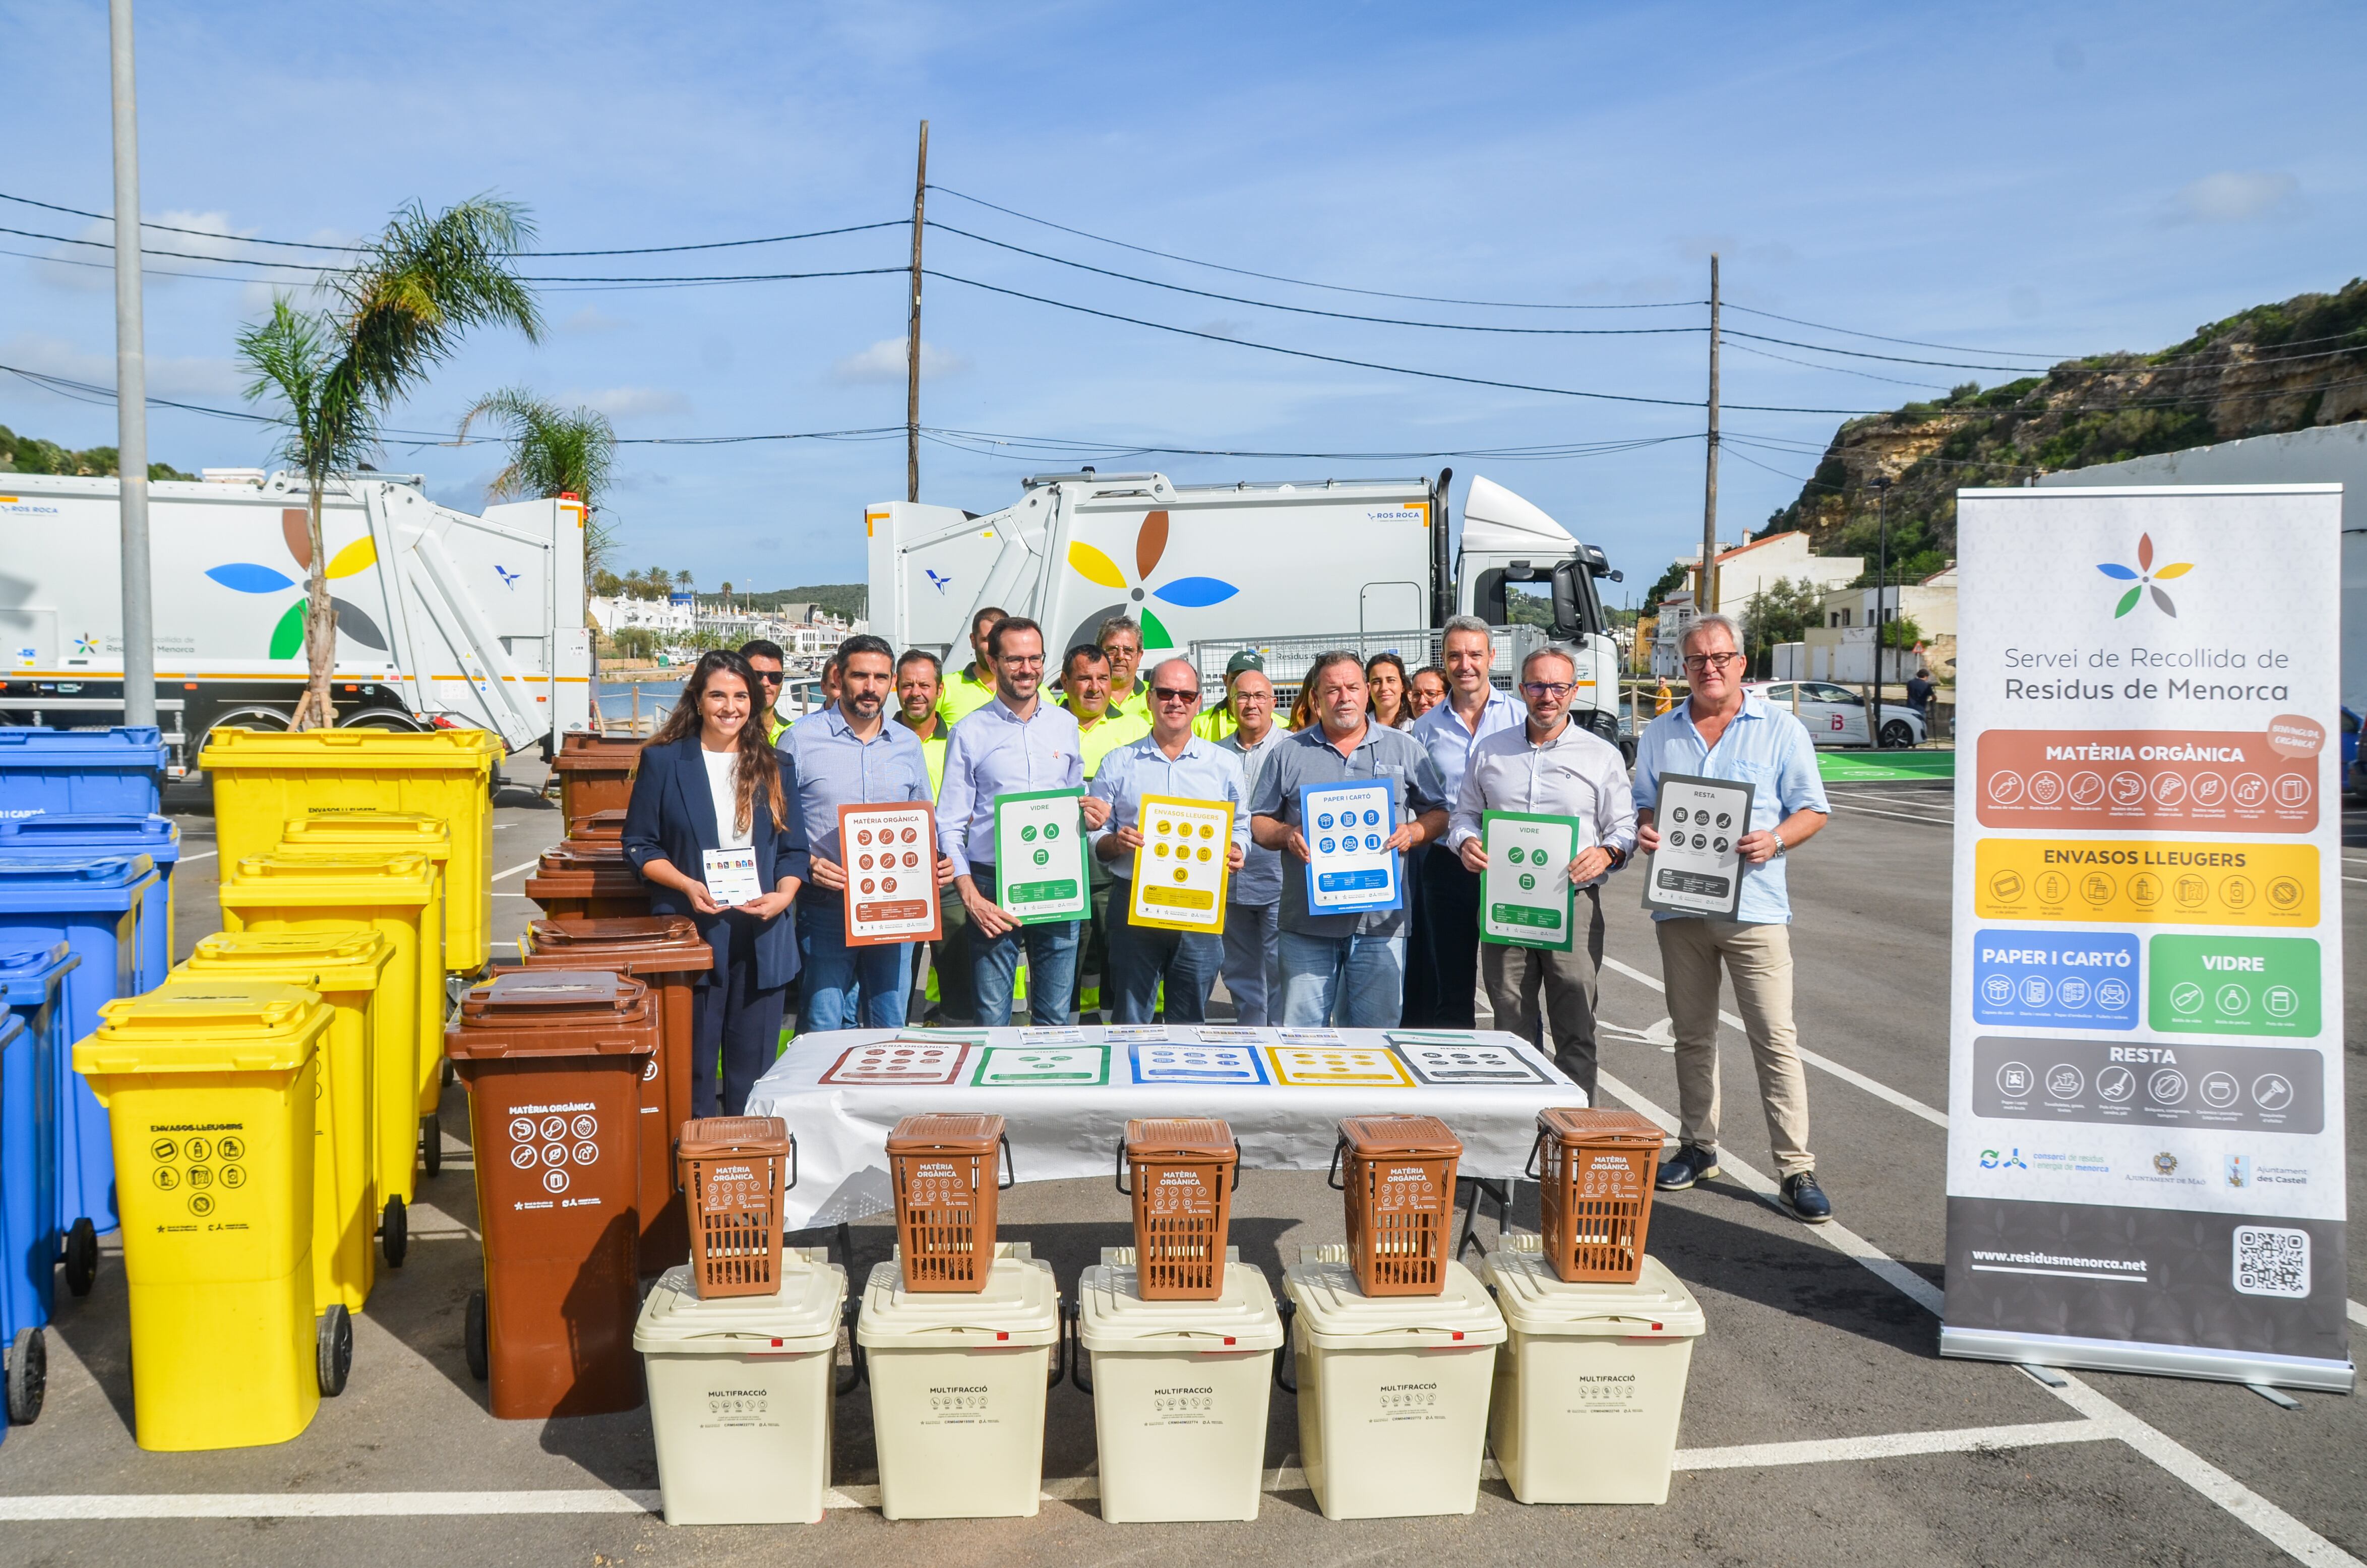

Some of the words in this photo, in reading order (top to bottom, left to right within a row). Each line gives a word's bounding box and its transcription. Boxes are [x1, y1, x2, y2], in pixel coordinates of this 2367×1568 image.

[2005, 648, 2078, 668] Servei
[2089, 649, 2119, 668] de
[2132, 648, 2246, 668] Recollida
[2258, 649, 2289, 668] de
[2006, 678, 2114, 700] Residus
[2123, 678, 2158, 700] de
[2168, 678, 2288, 701] Menorca
[2046, 742, 2136, 761] MATÈRIA
[2139, 743, 2245, 762] ORGÀNICA
[1349, 792, 1371, 800] CARTÓ
[1155, 808, 1185, 817] ENVASOS
[1186, 812, 1219, 820] LLEUGERS
[853, 817, 882, 825] MATÈRIA
[883, 815, 919, 823] ORGÀNICA
[2044, 850, 2139, 865] ENVASOS
[2144, 851, 2246, 867] LLEUGERS
[1982, 948, 2047, 965] PAPER
[2051, 951, 2057, 965] I
[2061, 949, 2132, 968] CARTÓ
[2201, 955, 2265, 972] VIDRE
[2109, 1046, 2177, 1064] RESTA
[509, 1104, 549, 1115] MATÈRIA
[549, 1102, 596, 1113] ORGÀNICA
[196, 1123, 244, 1131] LLEUGERS
[2079, 1154, 2104, 1163] residus
[716, 1166, 751, 1174] MATÈRIA
[2037, 1163, 2063, 1171] energia
[2075, 1165, 2109, 1173] menorca
[2257, 1166, 2308, 1176] Ajuntament
[712, 1173, 754, 1181] ORGÀNICA
[1387, 1174, 1427, 1182] ORGÀNICA
[2275, 1176, 2307, 1184] Castell
[1972, 1250, 2147, 1271] www.residusmenorca.net
[930, 1385, 988, 1394] MULTIFRACCIÓ
[1155, 1386, 1213, 1395] MULTIFRACCIÓ
[1380, 1382, 1437, 1392] MULTIFRACCIÓ
[708, 1389, 767, 1397] MULTIFRACCIÓ
